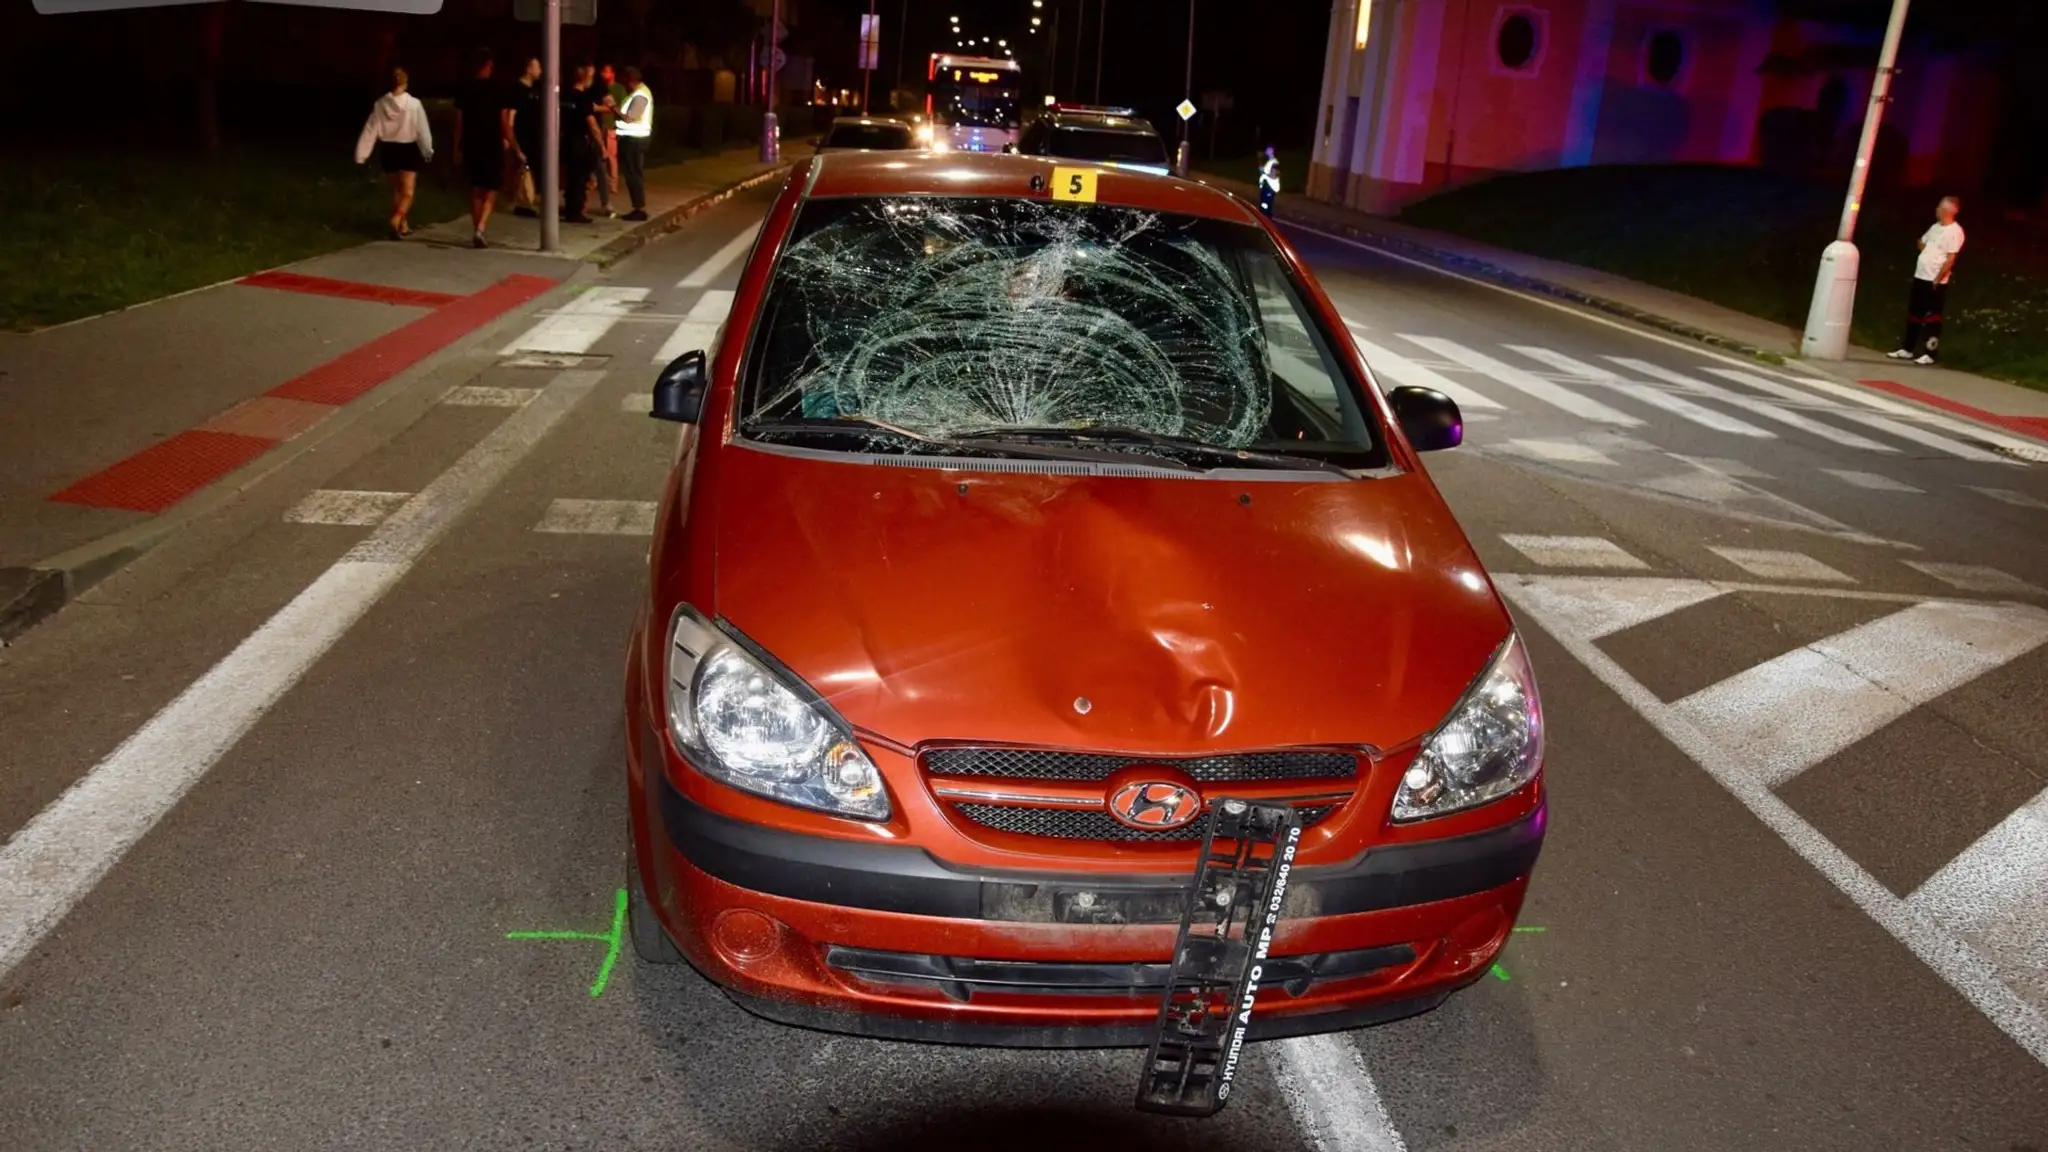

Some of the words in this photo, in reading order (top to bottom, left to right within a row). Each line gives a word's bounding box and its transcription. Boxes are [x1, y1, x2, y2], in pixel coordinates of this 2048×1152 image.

[1069, 174, 1083, 195] 5
[1287, 827, 1301, 842] 70
[1283, 845, 1296, 861] 20
[1269, 863, 1291, 911] 032/640
[1255, 926, 1272, 959] MP
[1239, 965, 1262, 1024] AUTO
[1223, 1027, 1246, 1080] HYUNDAI
